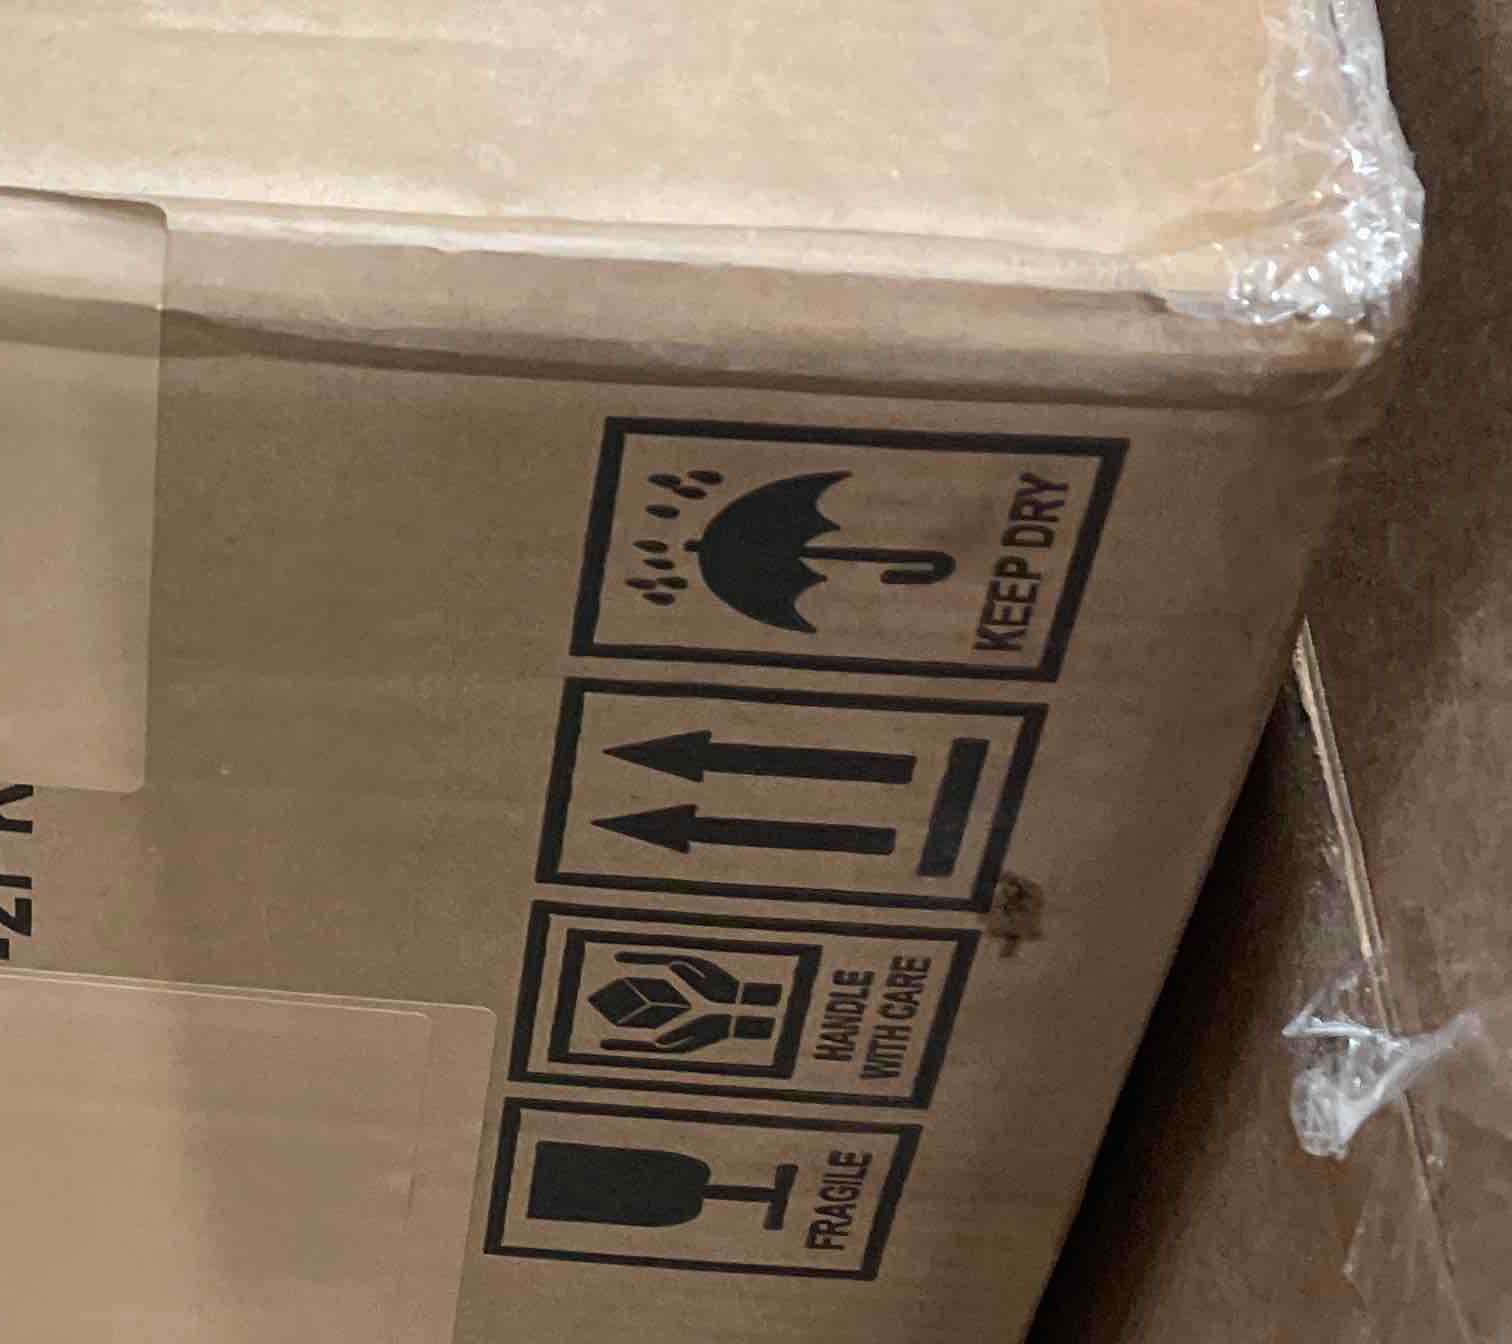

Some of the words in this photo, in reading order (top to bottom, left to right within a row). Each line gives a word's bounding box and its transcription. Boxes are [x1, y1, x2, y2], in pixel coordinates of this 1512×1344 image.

[1000, 472, 1069, 549] DRY
[973, 556, 1041, 651] KEEP
[813, 970, 875, 1062] HANDLE
[880, 955, 931, 1019] CARE
[860, 1018, 912, 1080] WITH
[806, 1150, 872, 1252] FRAGILE
